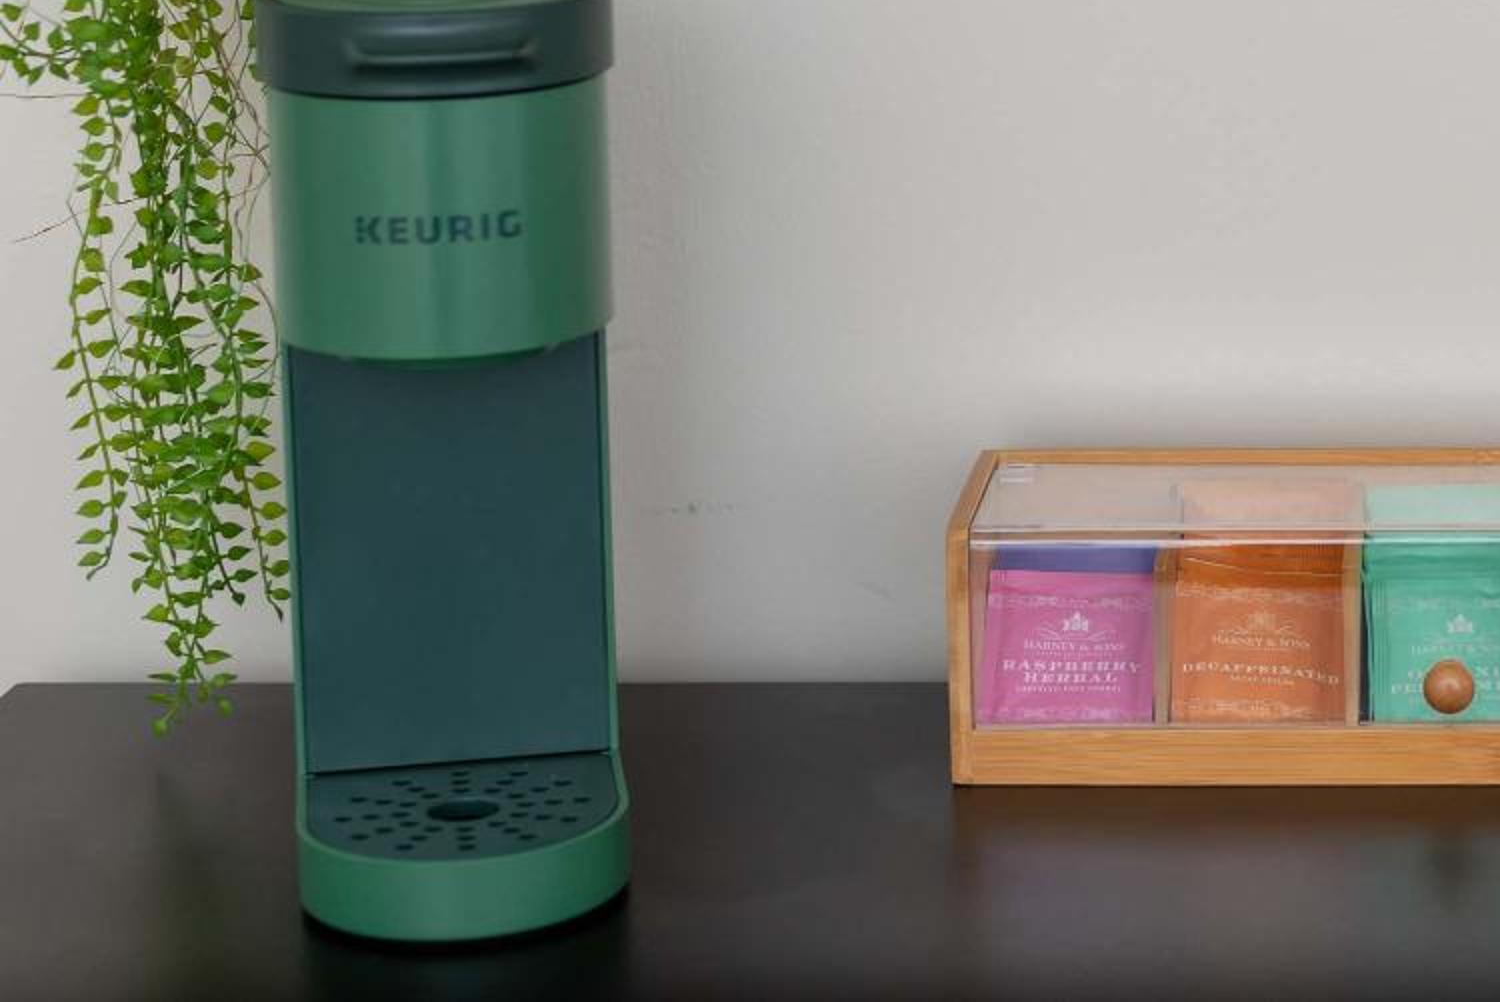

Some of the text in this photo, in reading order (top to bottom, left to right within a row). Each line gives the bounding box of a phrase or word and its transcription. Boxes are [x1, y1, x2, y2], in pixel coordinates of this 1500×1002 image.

[355, 209, 522, 245] KEURIG
[1002, 658, 1141, 674] RASPBERRY
[1023, 671, 1119, 684] HERBAL
